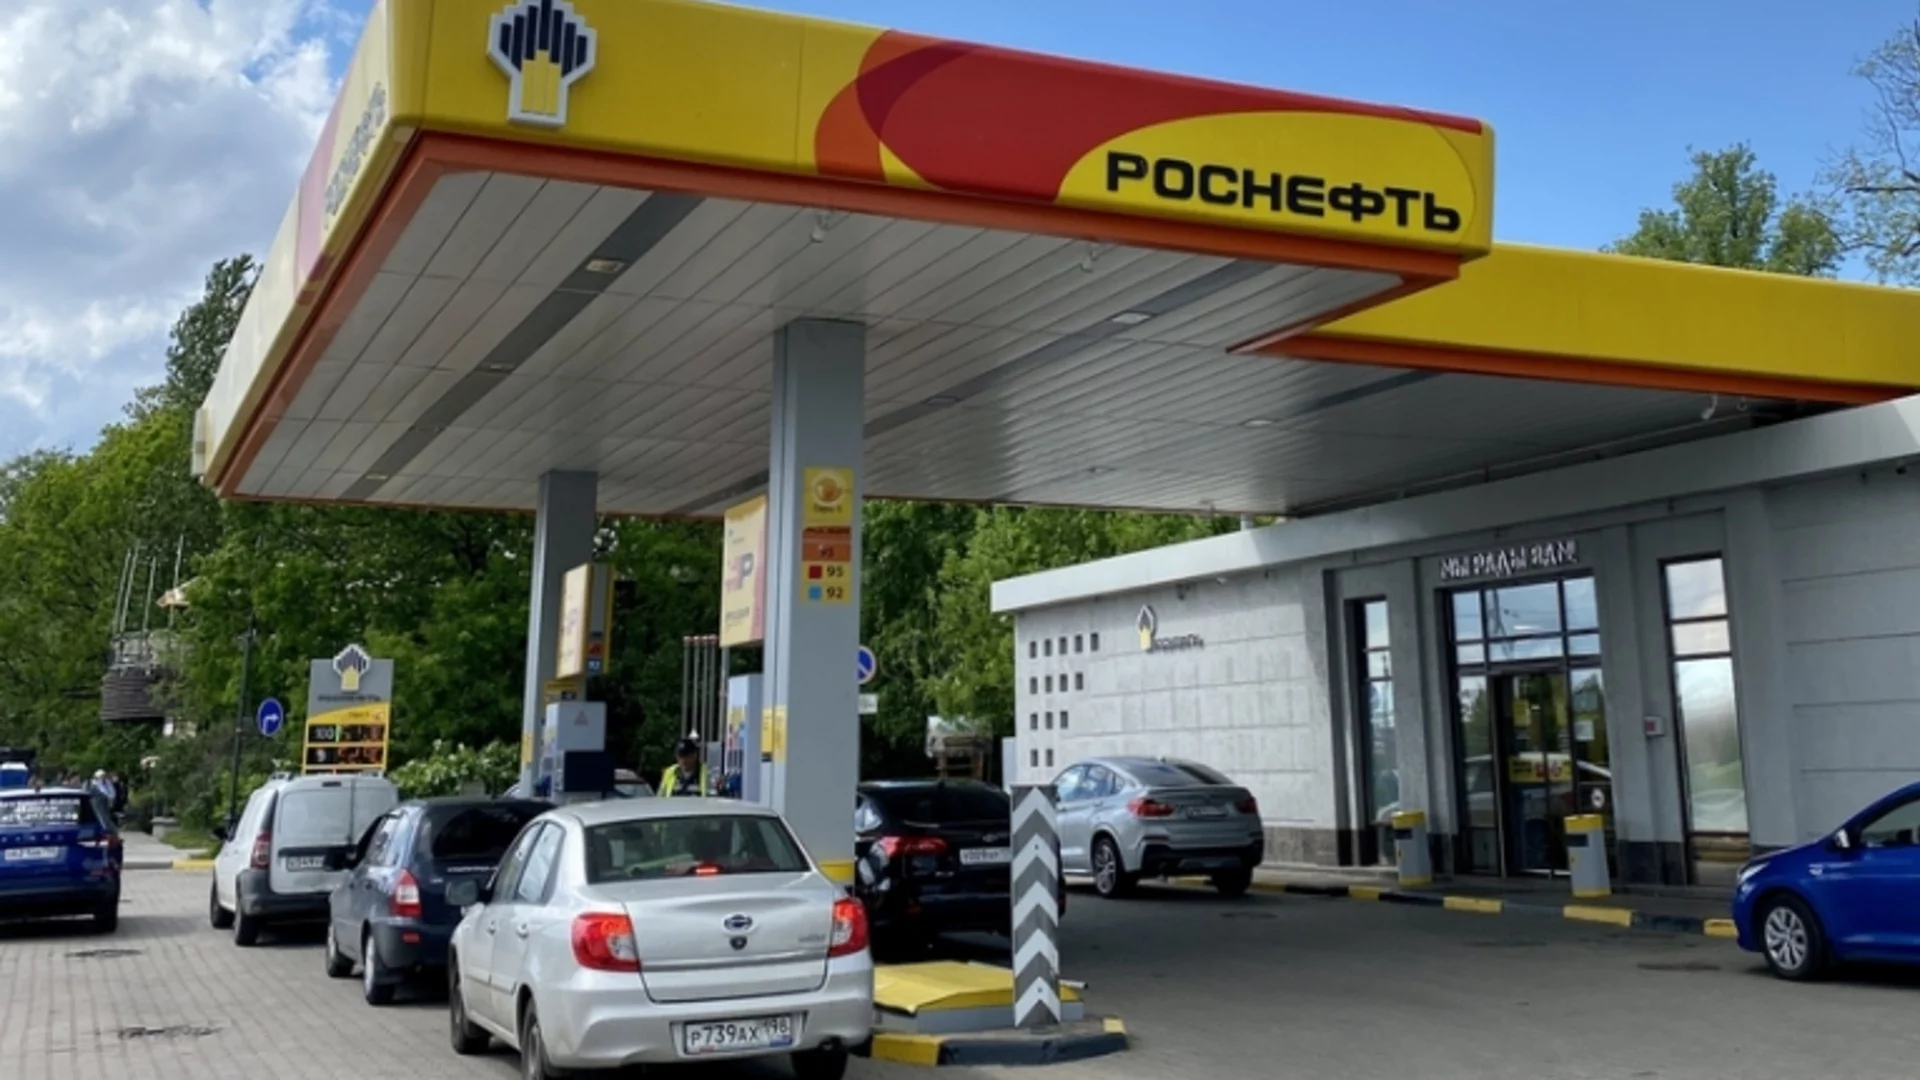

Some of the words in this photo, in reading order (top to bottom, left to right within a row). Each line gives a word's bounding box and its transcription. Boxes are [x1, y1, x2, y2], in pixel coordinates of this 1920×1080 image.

[1106, 151, 1461, 233] РОСНЕФТЬ
[827, 565, 844, 578] 95
[827, 586, 844, 600] 92
[690, 1024, 758, 1046] Р739АХ
